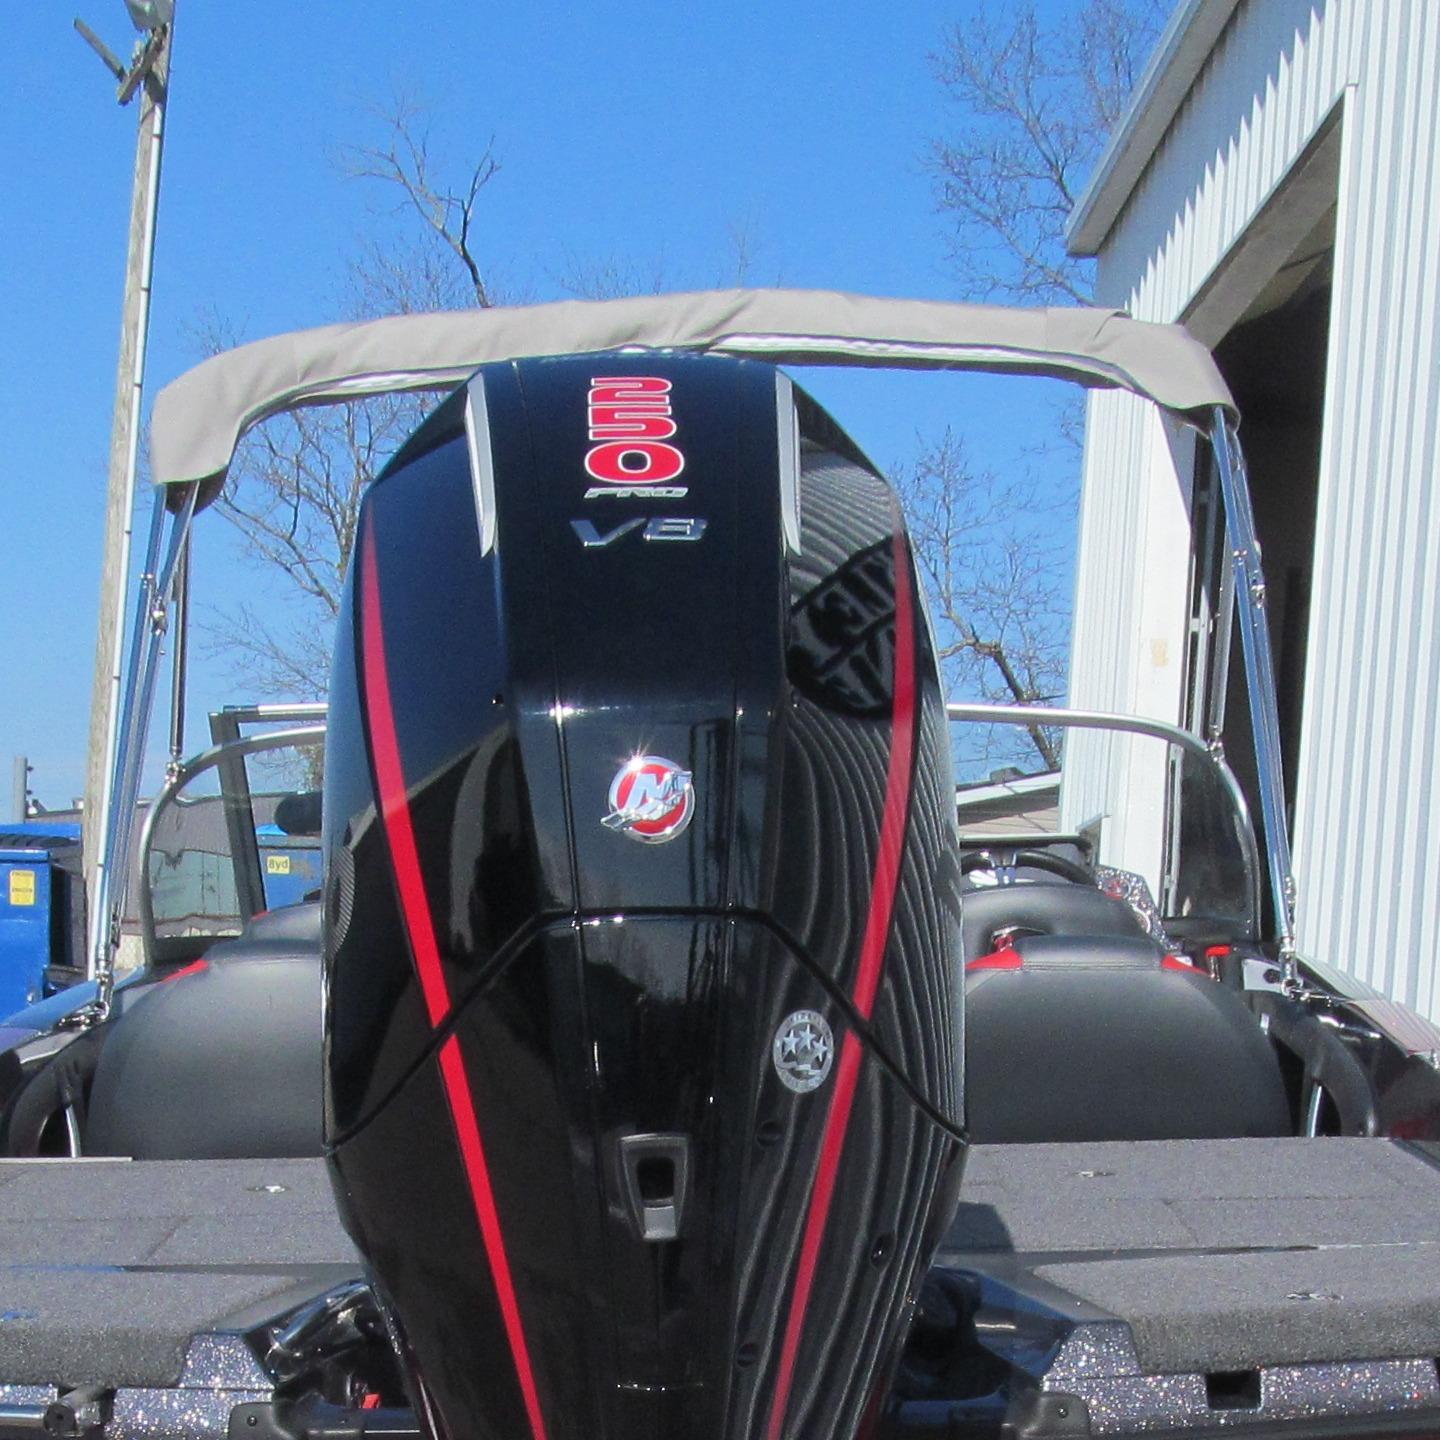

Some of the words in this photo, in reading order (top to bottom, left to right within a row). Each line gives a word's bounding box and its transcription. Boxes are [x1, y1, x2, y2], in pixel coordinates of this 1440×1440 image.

[584, 376, 685, 484] 250
[583, 486, 689, 499] PRO
[268, 858, 288, 871] 8yd
